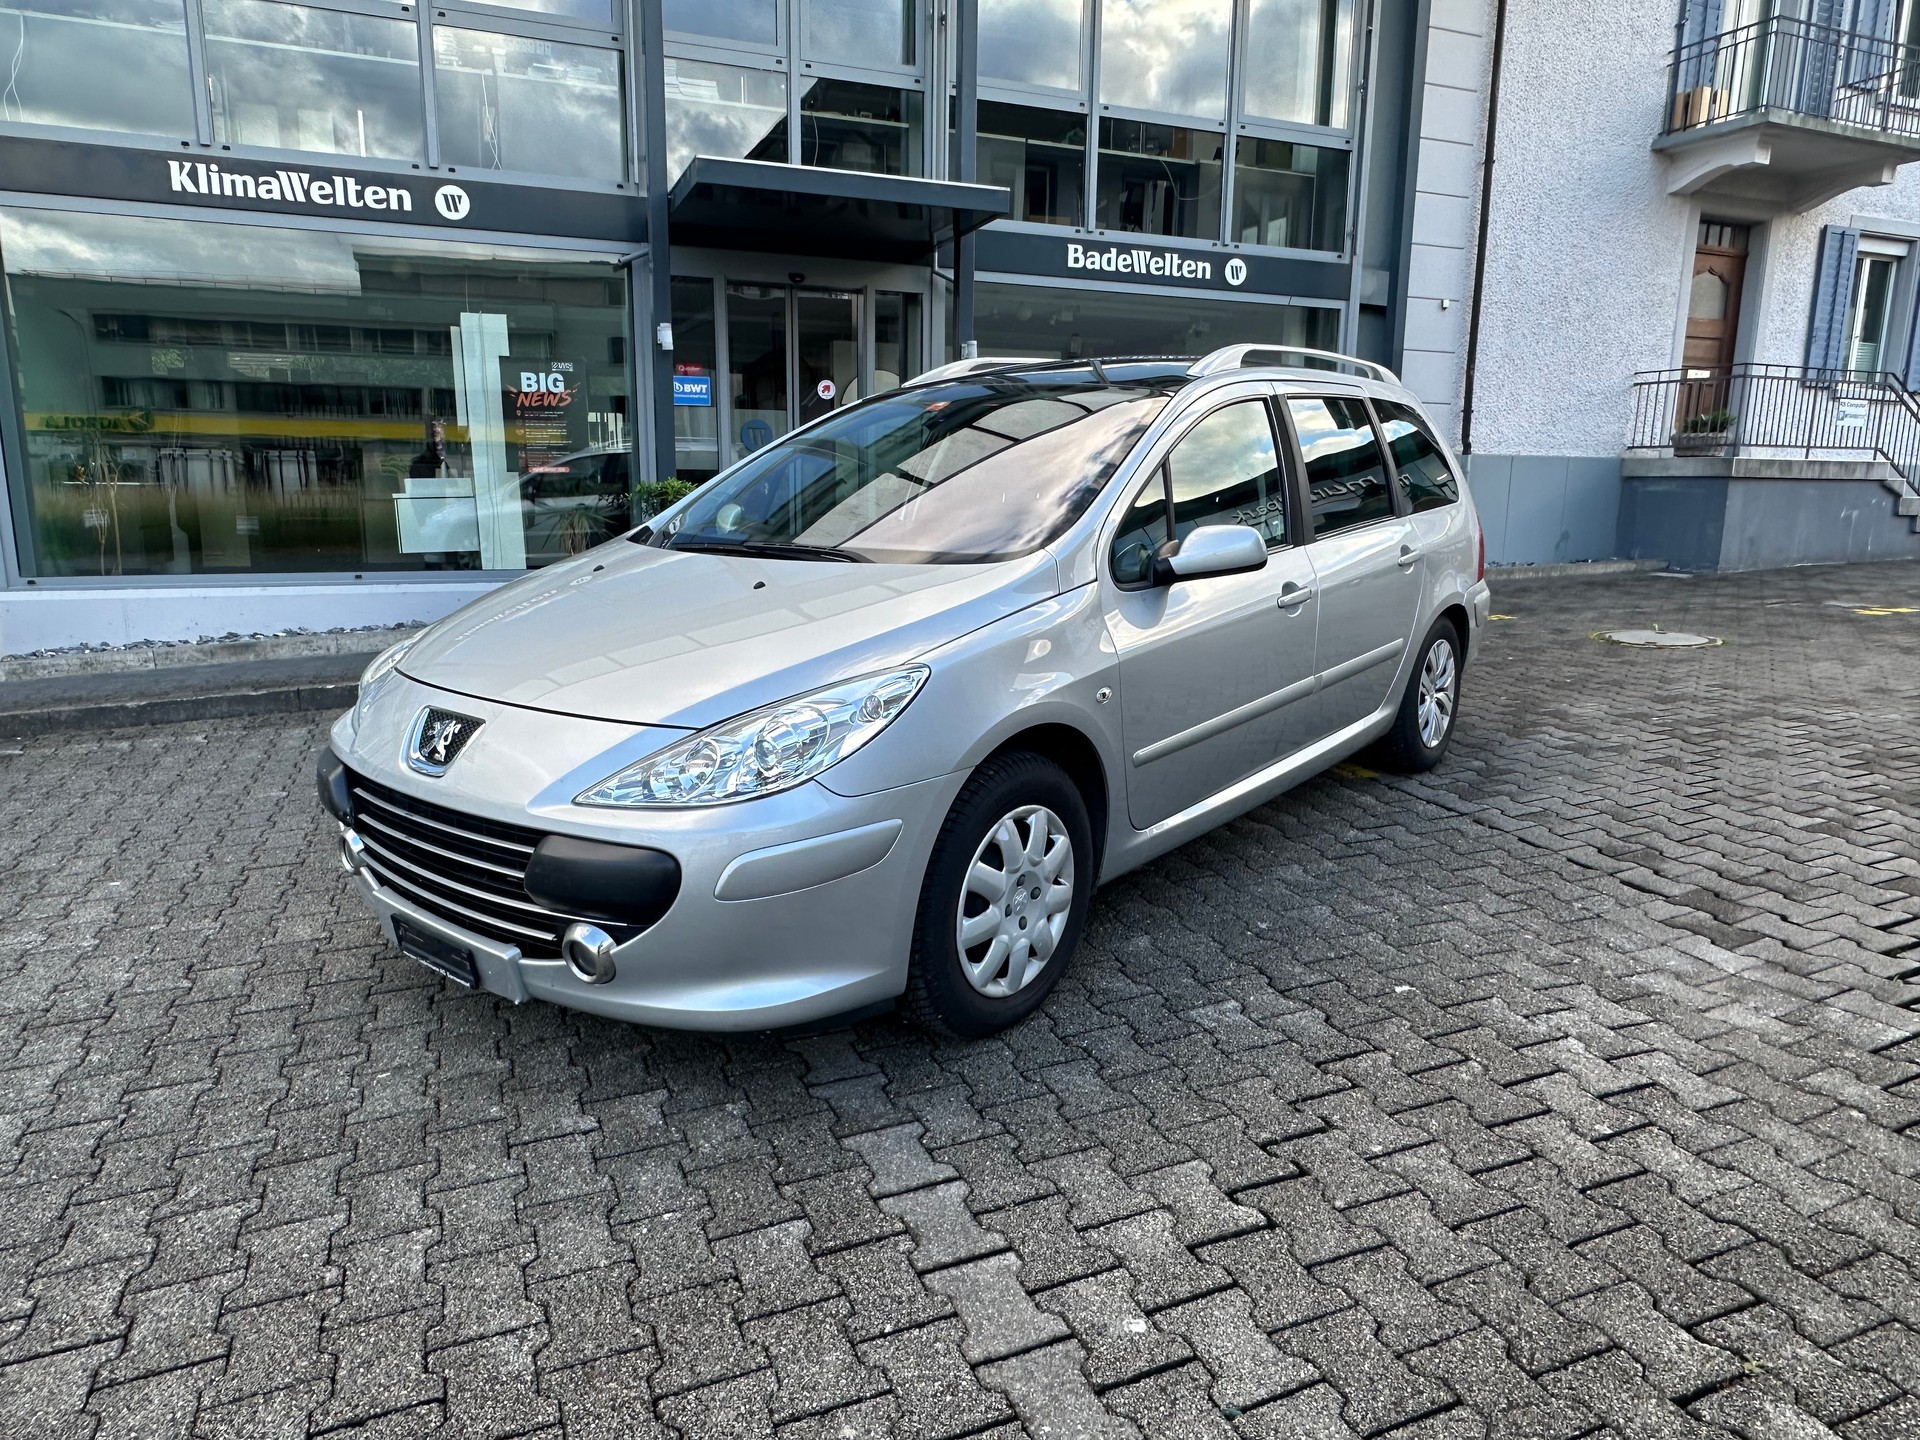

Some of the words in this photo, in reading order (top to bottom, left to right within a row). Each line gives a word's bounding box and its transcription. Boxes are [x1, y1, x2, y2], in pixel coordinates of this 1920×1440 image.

[167, 160, 412, 212] KlimaWelten
[1067, 243, 1212, 280] BadeWelten
[520, 371, 565, 393] BIG
[683, 384, 708, 394] BWT
[517, 389, 572, 408] NEWS
